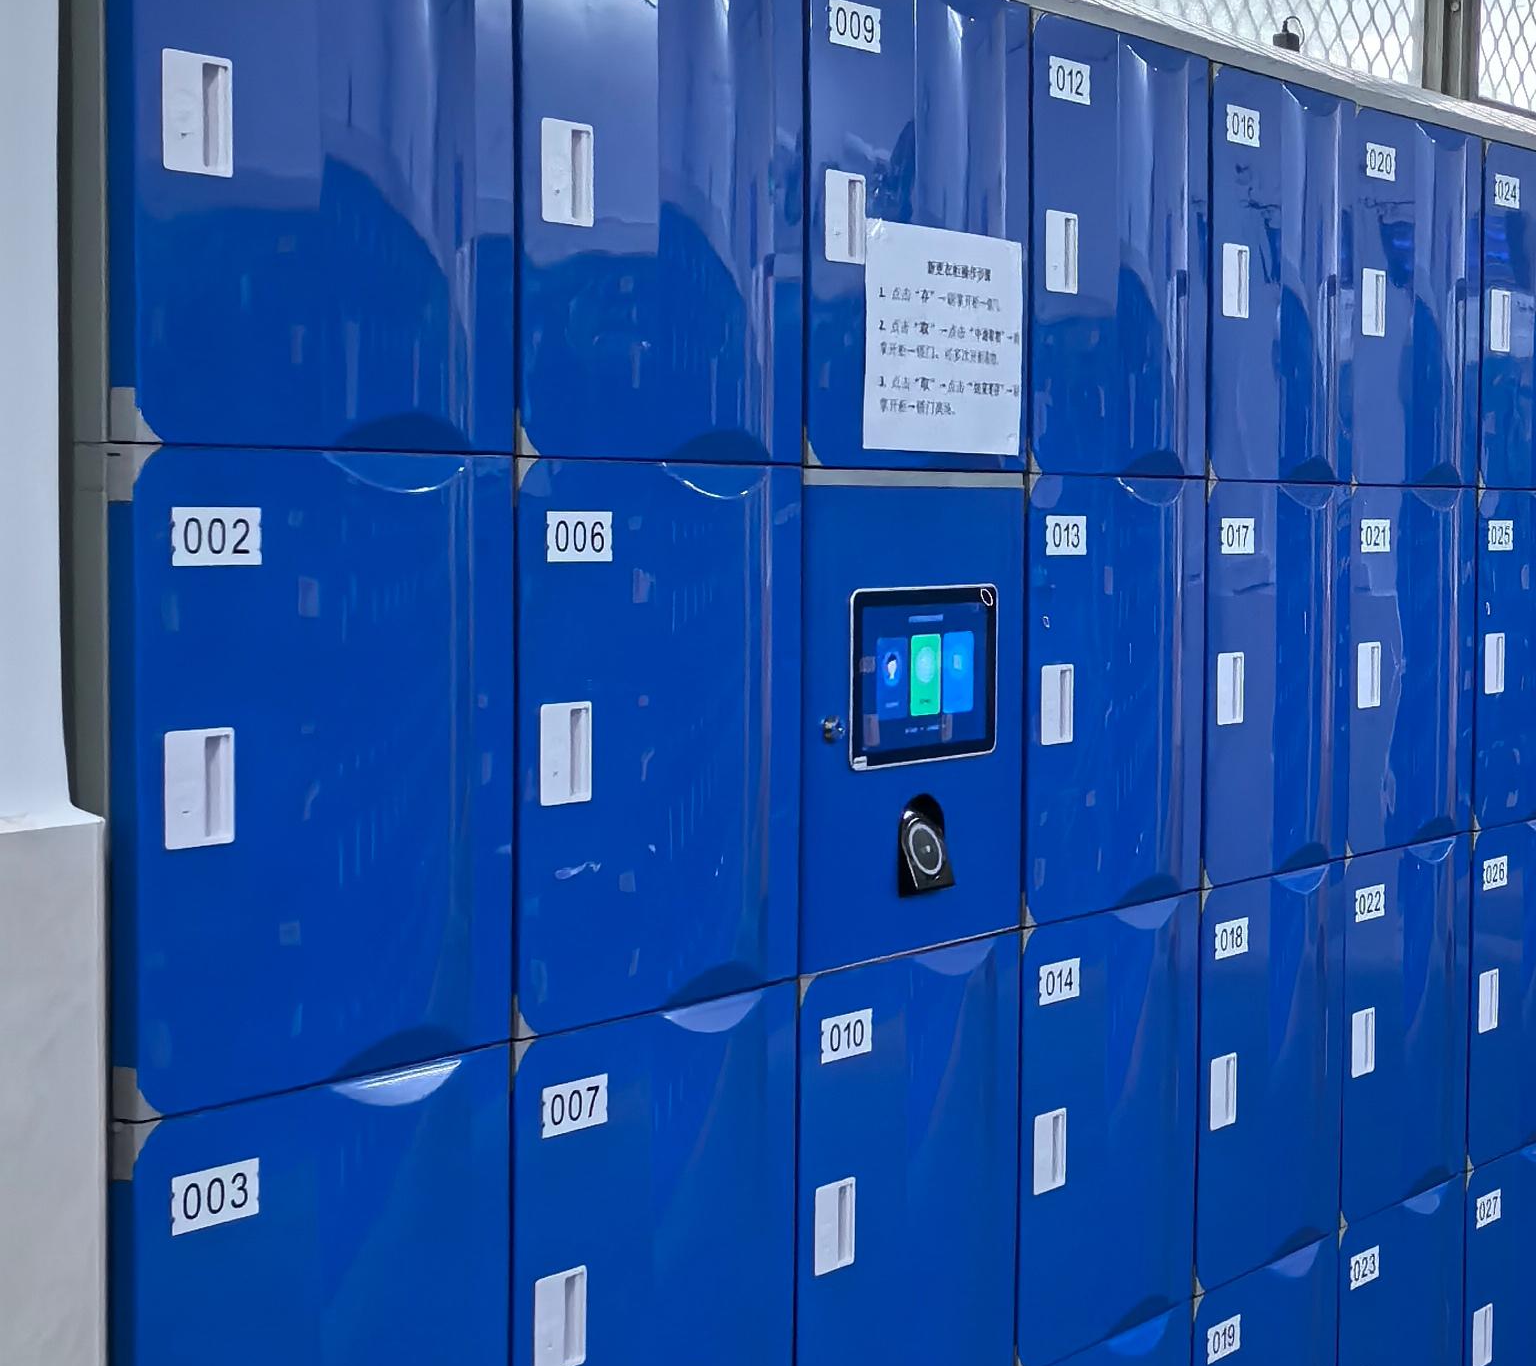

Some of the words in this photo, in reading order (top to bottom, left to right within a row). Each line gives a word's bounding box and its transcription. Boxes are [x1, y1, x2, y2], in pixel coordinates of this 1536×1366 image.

[836, 7, 874, 43] 009
[1057, 65, 1083, 96] 012
[1232, 112, 1254, 139] 016
[1370, 149, 1392, 175] 020
[1498, 180, 1516, 204] 024
[184, 517, 250, 554] 002
[555, 521, 604, 553] 006
[1053, 523, 1079, 548] 013
[1227, 525, 1249, 547] 017
[1366, 526, 1386, 547] 021
[1491, 526, 1510, 545] 025
[1486, 862, 1504, 883] 026
[1359, 891, 1381, 915] 022
[1221, 925, 1242, 951] 018
[1046, 967, 1073, 996] 014
[830, 1019, 864, 1052] 010
[551, 1085, 599, 1125] 007
[184, 1173, 248, 1219] 003
[1479, 1196, 1498, 1221] 027
[1354, 1254, 1375, 1281] 023
[1213, 1324, 1235, 1353] 019
